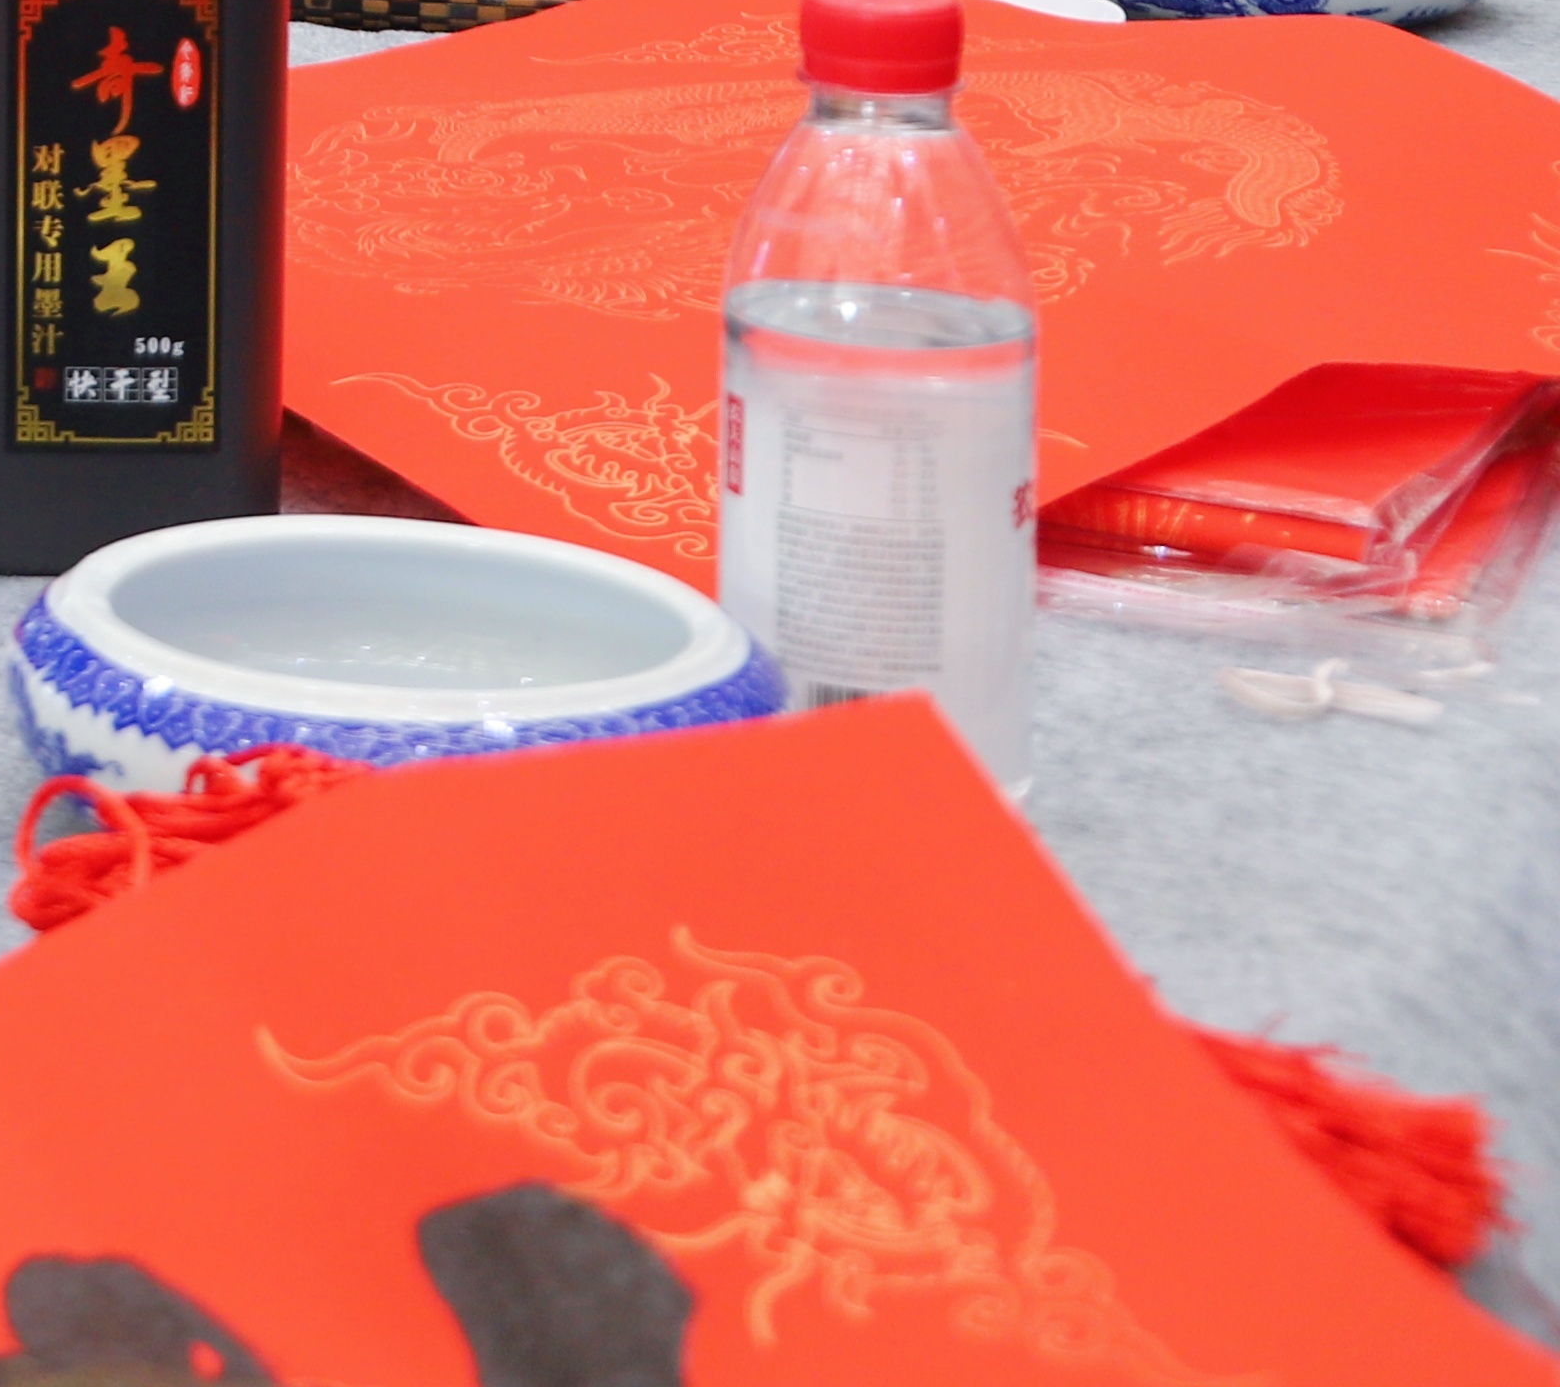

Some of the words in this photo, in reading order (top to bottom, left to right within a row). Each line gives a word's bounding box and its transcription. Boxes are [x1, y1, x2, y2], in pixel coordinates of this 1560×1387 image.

[72, 26, 164, 318] 奇墨王
[31, 142, 65, 355] 对联专用墨汁
[68, 367, 172, 402] 快干型
[134, 336, 185, 357] 500g
